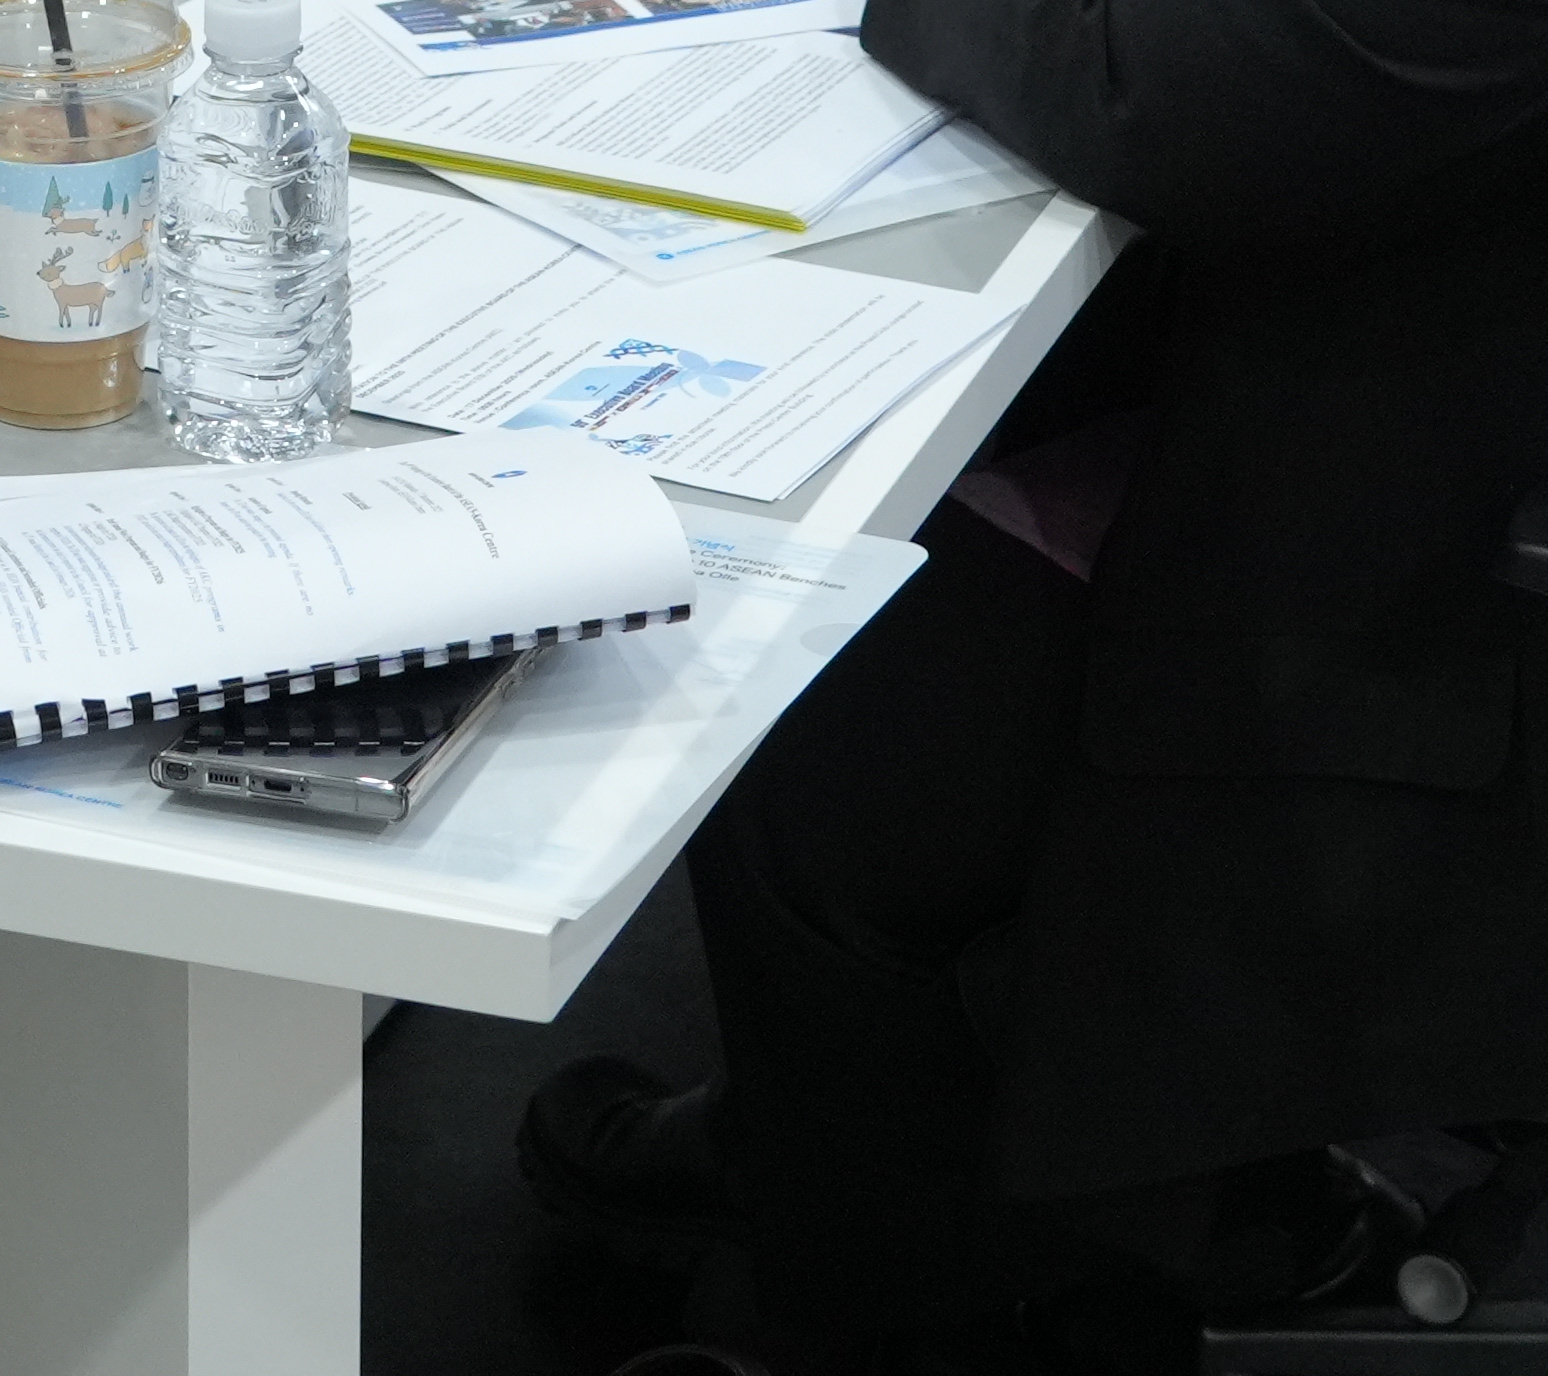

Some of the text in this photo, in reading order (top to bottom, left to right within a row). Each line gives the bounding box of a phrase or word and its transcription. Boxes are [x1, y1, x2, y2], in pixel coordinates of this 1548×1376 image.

[481, 531, 502, 559] Centre
[718, 561, 776, 579] ASEAN
[778, 572, 848, 591] Benches
